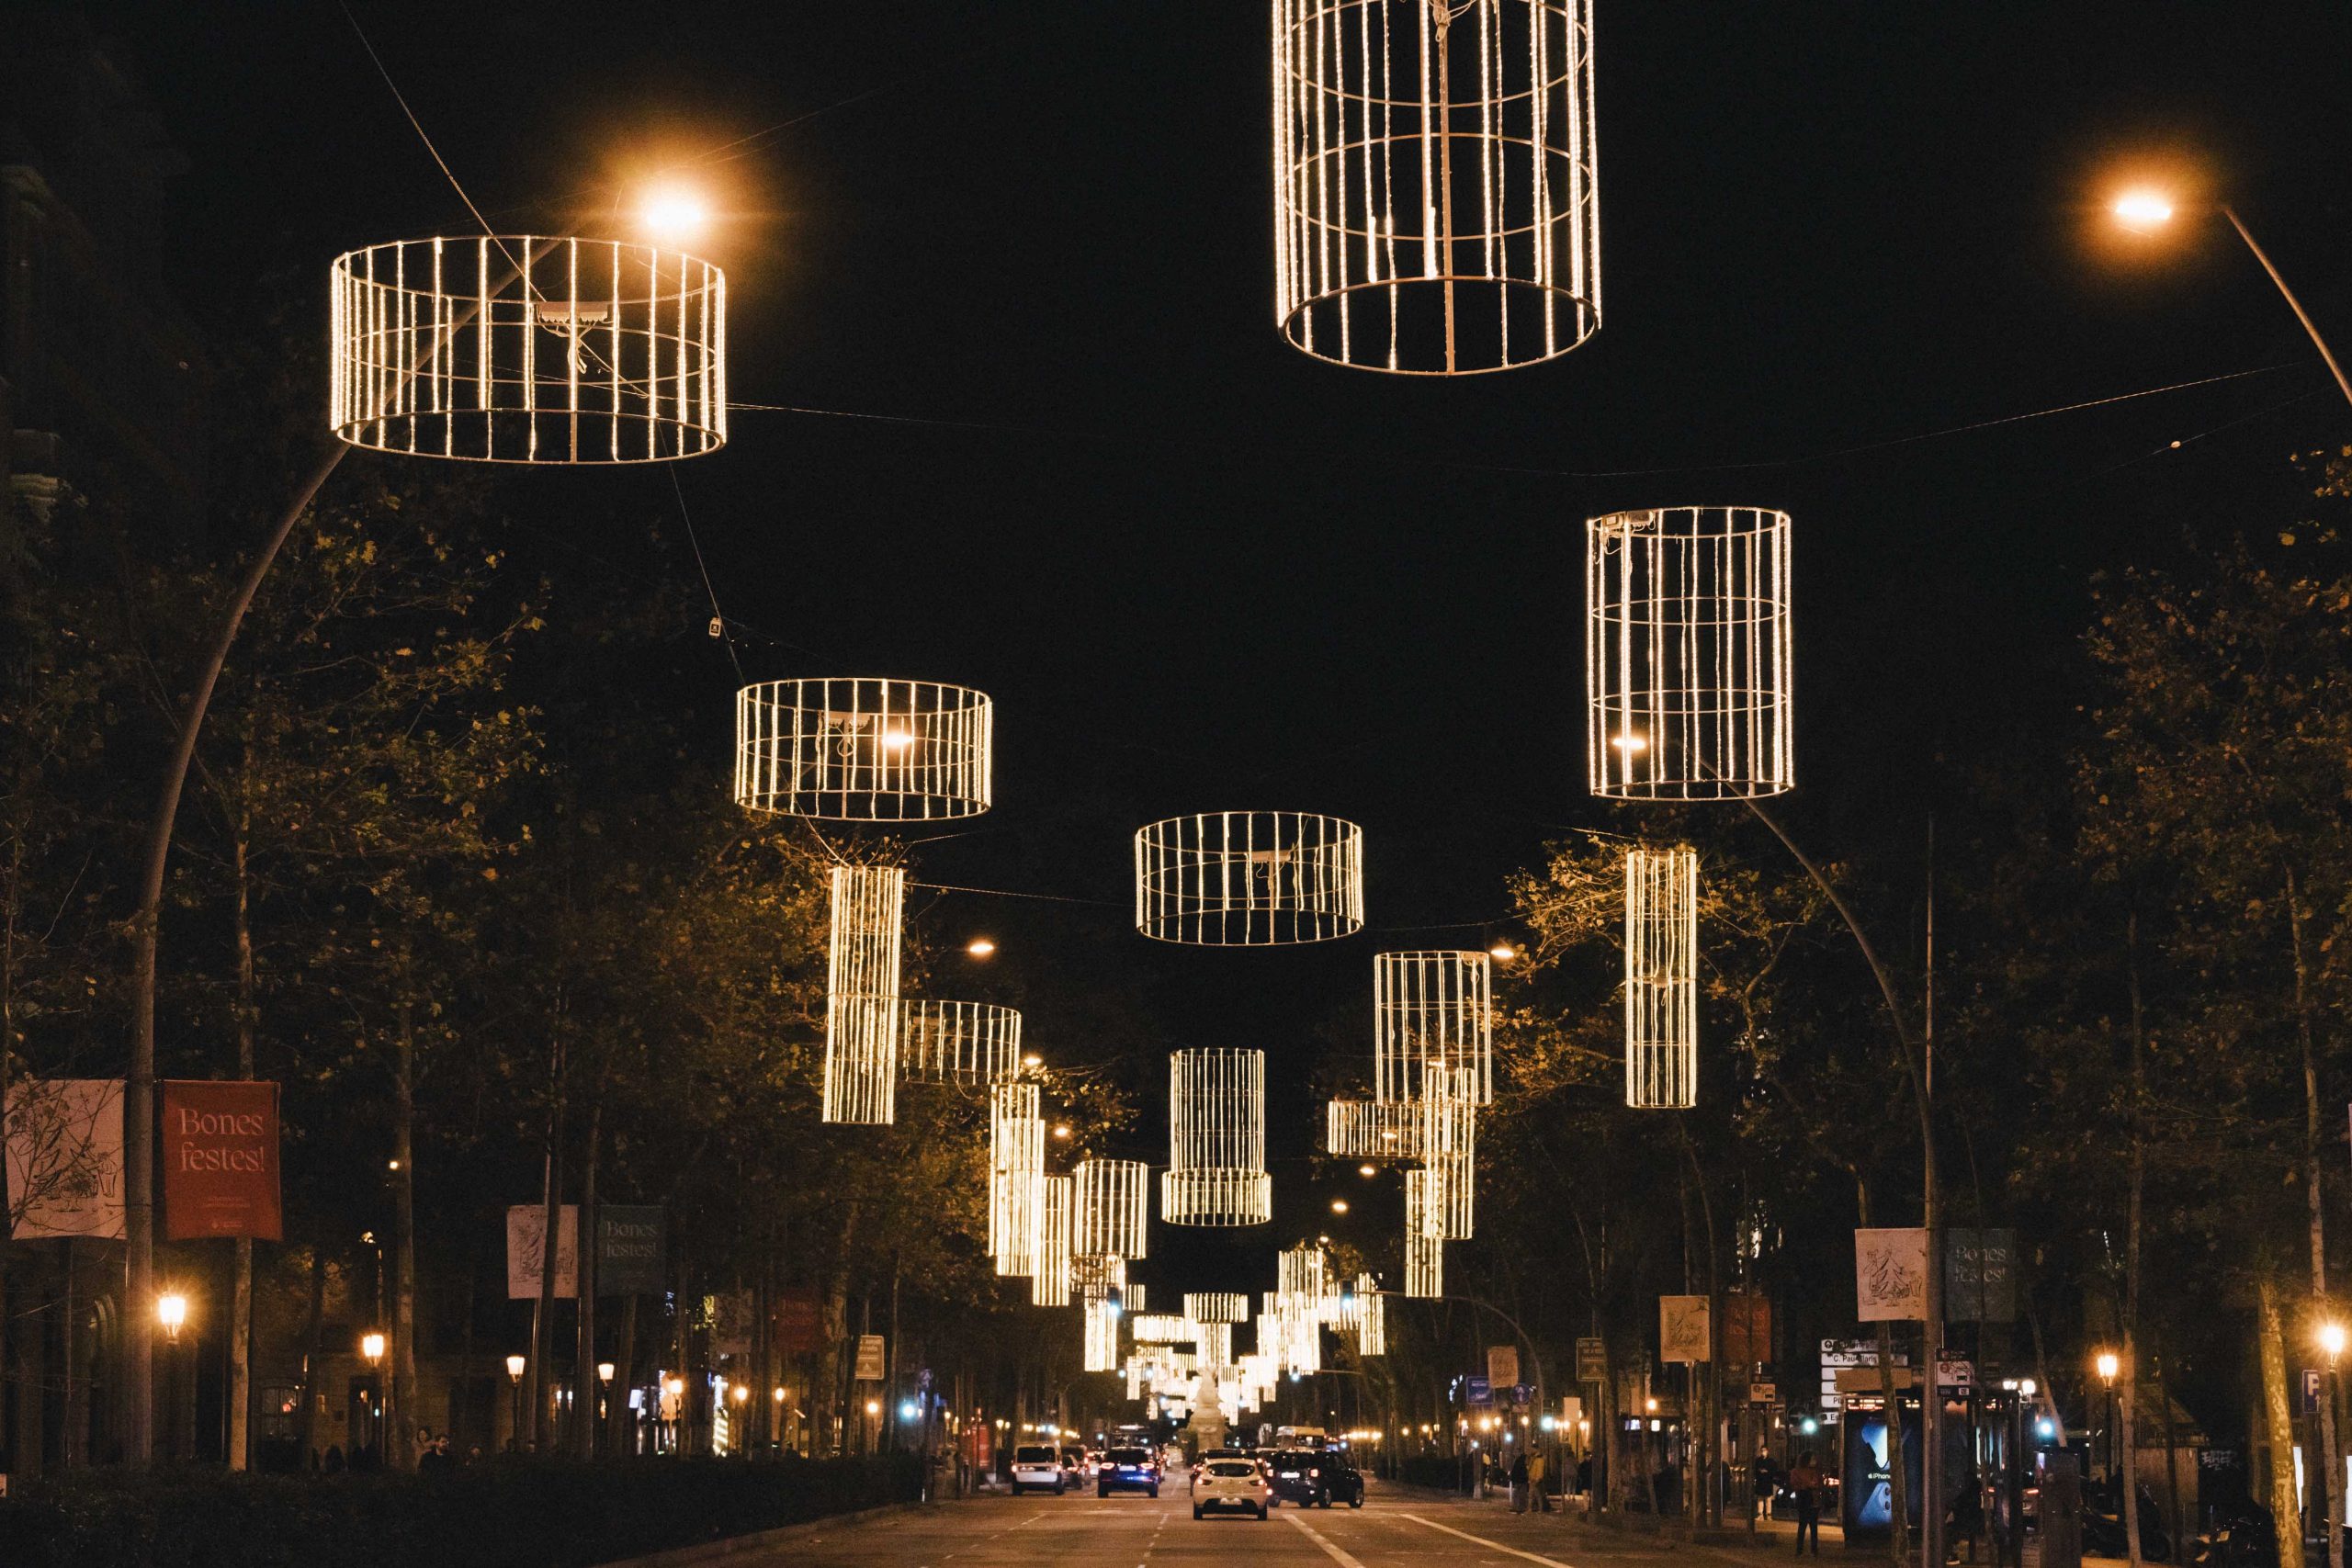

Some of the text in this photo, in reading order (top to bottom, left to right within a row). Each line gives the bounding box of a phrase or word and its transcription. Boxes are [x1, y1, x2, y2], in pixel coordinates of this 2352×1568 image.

[179, 1108, 265, 1135] Bones
[180, 1141, 265, 1173] festes!
[605, 1221, 659, 1237] Bones
[606, 1240, 657, 1258] festes!
[1955, 1263, 2007, 1282] feses!
[1842, 1354, 1855, 1362] Pau
[2307, 1373, 2320, 1396] P
